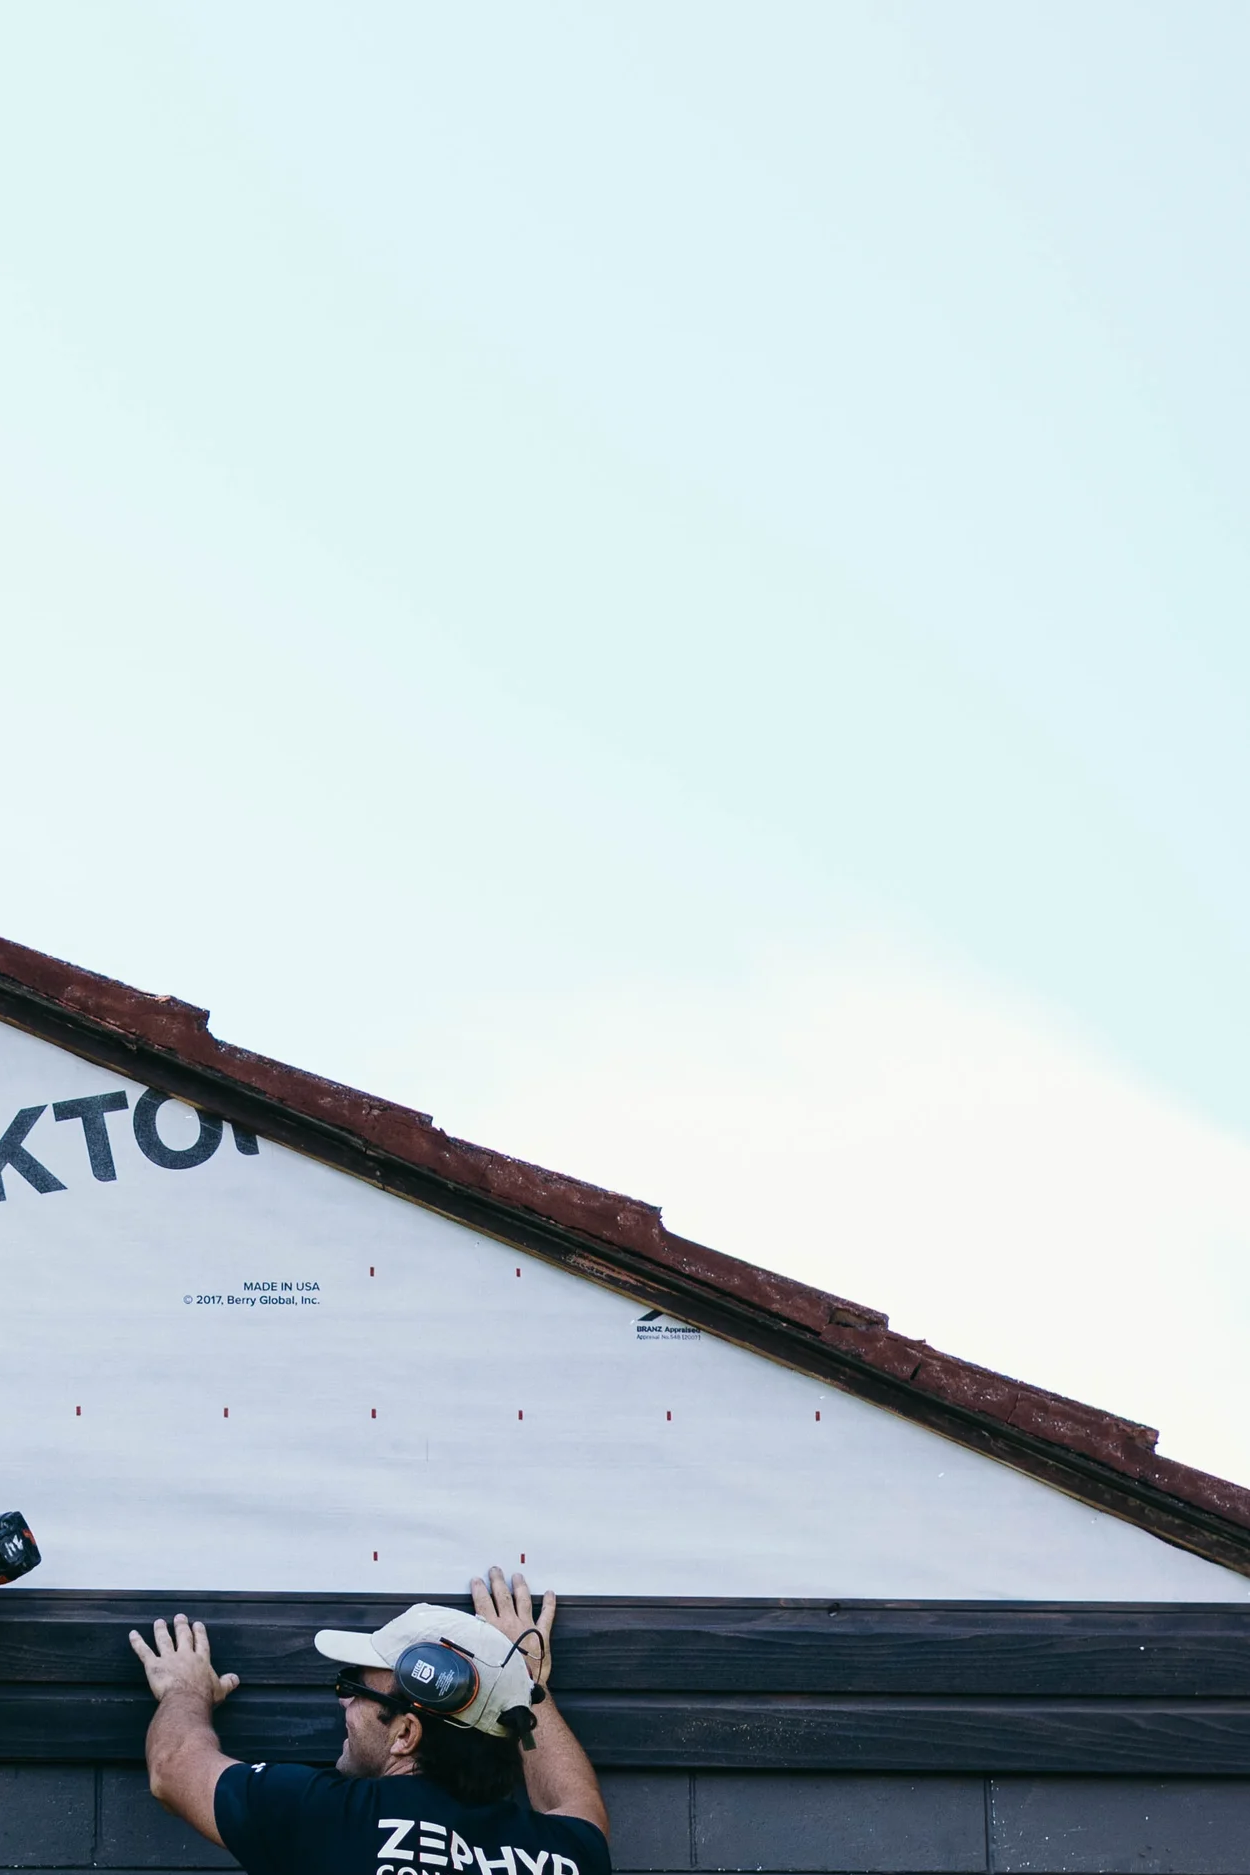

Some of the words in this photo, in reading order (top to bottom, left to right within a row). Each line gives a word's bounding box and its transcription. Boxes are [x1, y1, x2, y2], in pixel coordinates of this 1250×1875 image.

[243, 1282, 277, 1291] MADE
[281, 1282, 292, 1291] IN
[296, 1282, 320, 1291] USA
[196, 1295, 224, 1305] 2017,
[227, 1295, 256, 1307] Berry
[259, 1295, 298, 1306] Global,
[301, 1295, 320, 1304] Inc.
